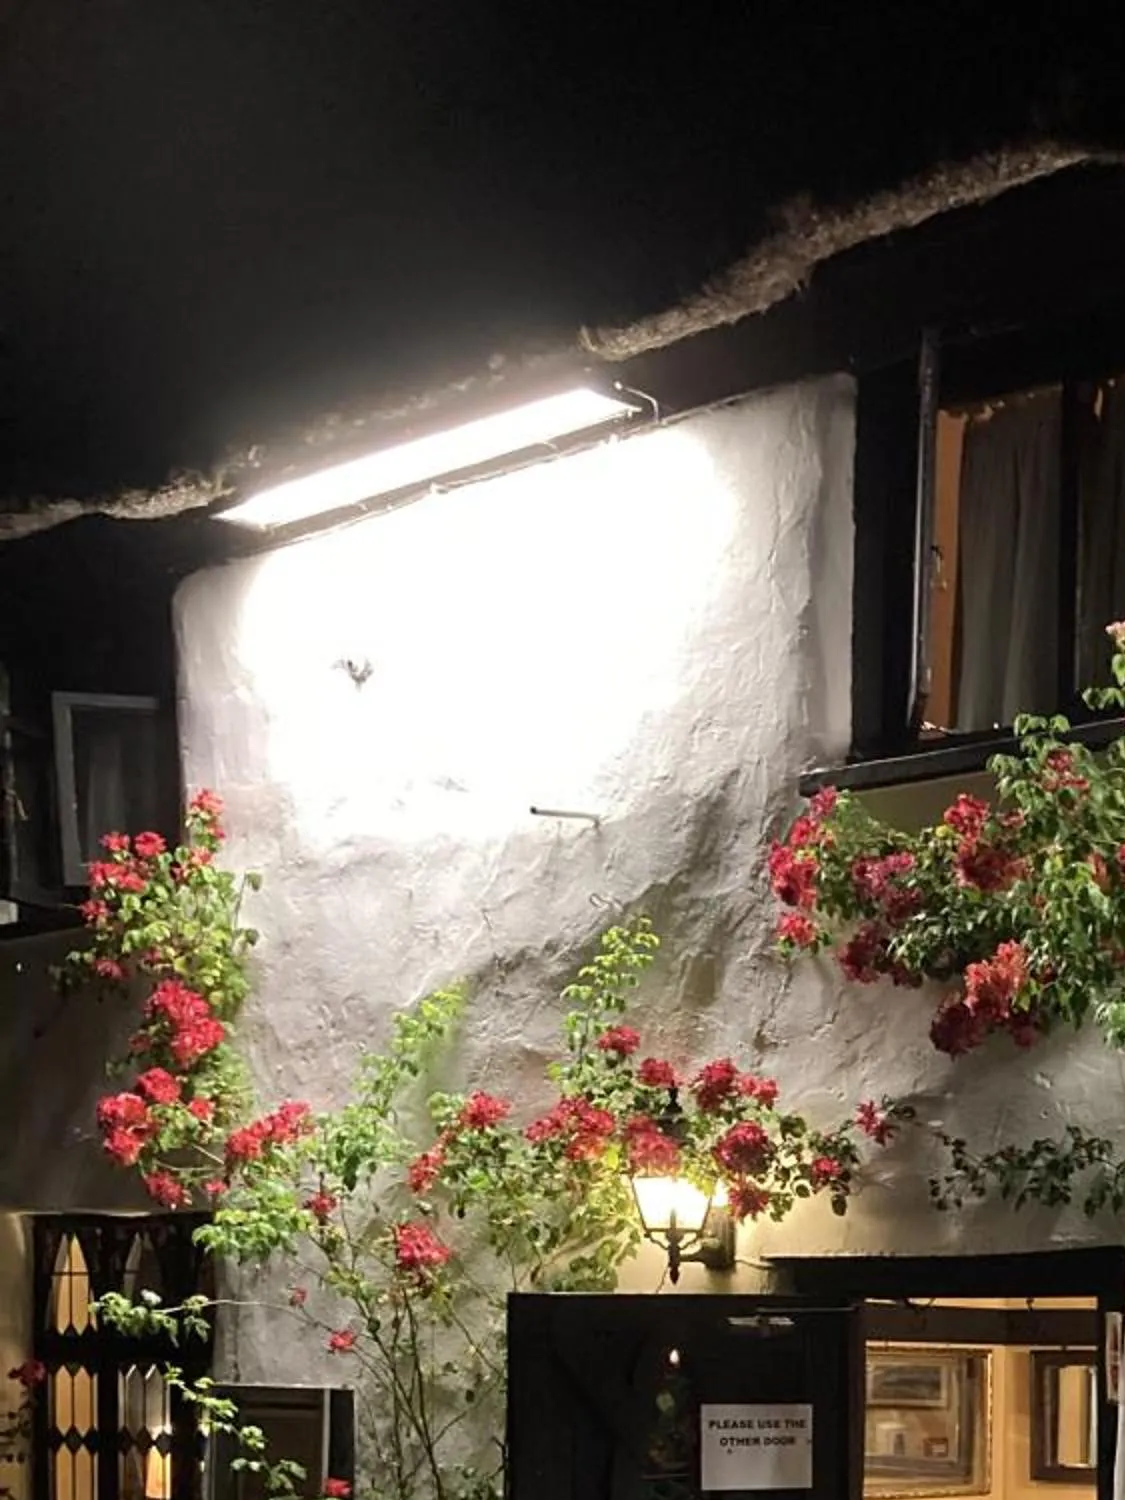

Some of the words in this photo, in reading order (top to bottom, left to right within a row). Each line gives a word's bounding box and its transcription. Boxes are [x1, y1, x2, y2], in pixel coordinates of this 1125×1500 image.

[708, 1419, 753, 1429] PLEASE
[757, 1419, 781, 1429] USE
[785, 1419, 806, 1429] THE
[719, 1437, 760, 1447] OTHER
[763, 1436, 795, 1446] DOOR
